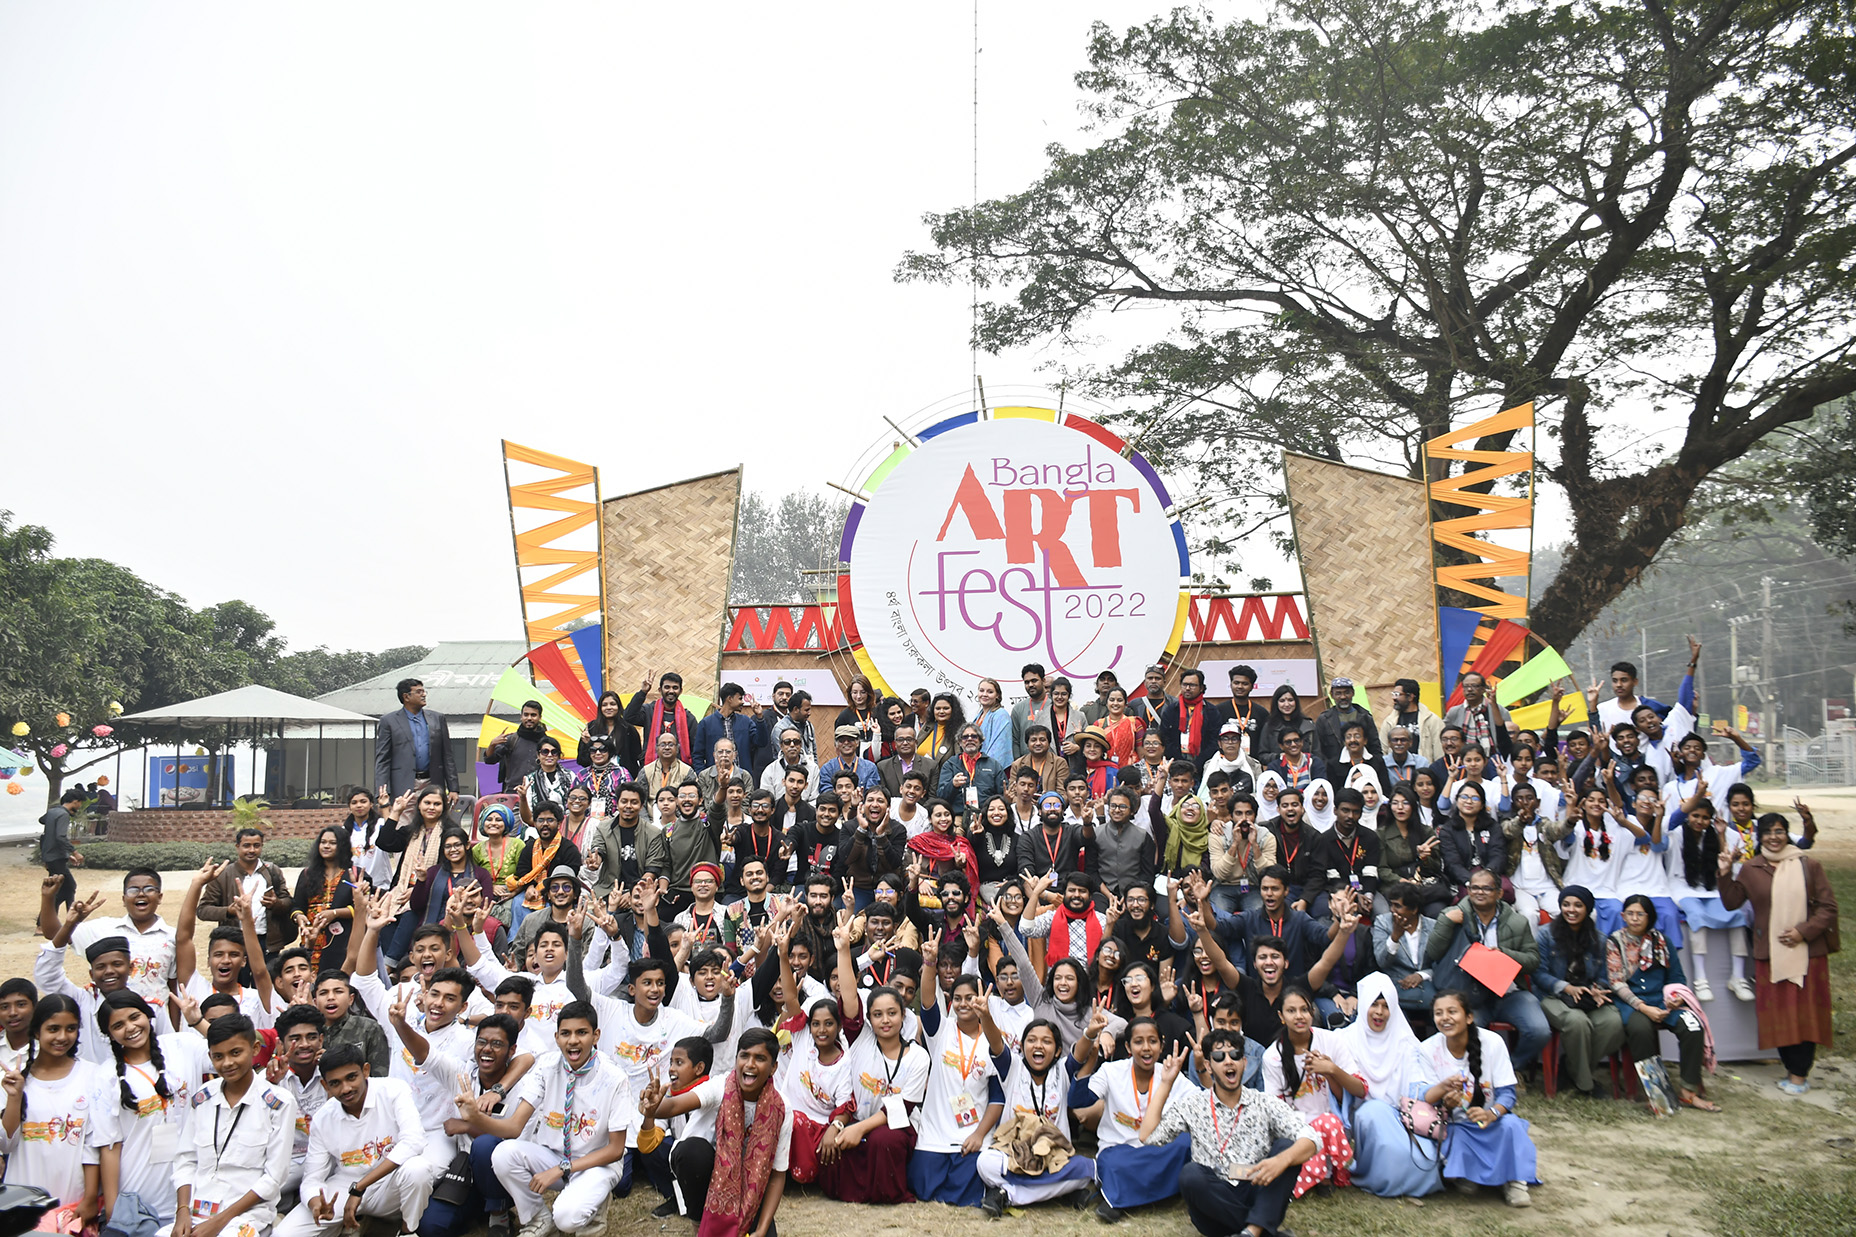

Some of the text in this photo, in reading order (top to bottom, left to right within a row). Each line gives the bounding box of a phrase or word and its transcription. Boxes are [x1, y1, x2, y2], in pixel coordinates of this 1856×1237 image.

[989, 444, 1115, 498] Bangla
[936, 462, 1141, 588] ART
[918, 549, 1124, 680] Fest
[1065, 592, 1146, 618] 2022
[890, 609, 907, 638] বাংলা
[902, 638, 935, 676] চারুকলা
[935, 669, 965, 696] উৎসব
